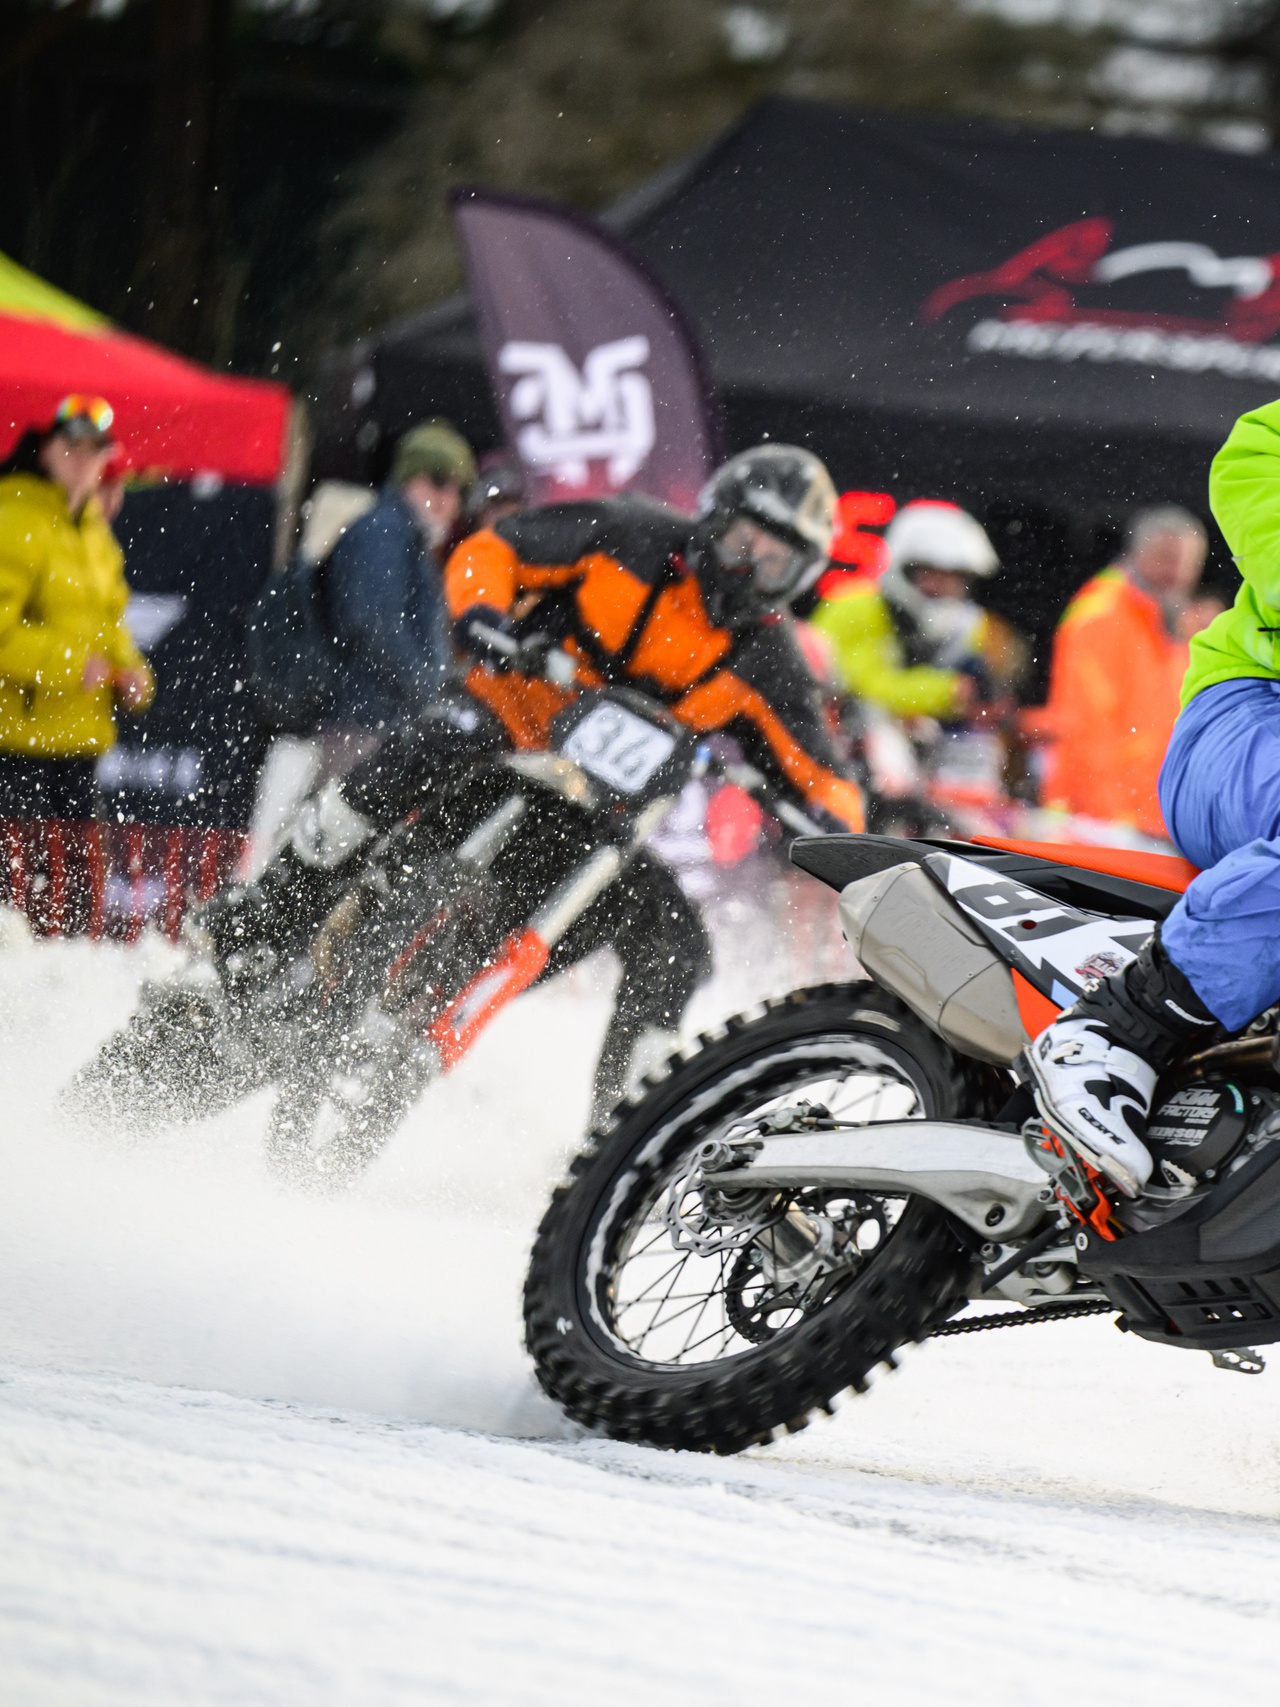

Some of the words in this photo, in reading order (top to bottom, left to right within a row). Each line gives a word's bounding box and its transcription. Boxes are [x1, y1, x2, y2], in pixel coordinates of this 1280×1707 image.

[952, 881, 1104, 942] 81
[1168, 1088, 1222, 1107] KTM
[1156, 1104, 1221, 1119] FACTORY
